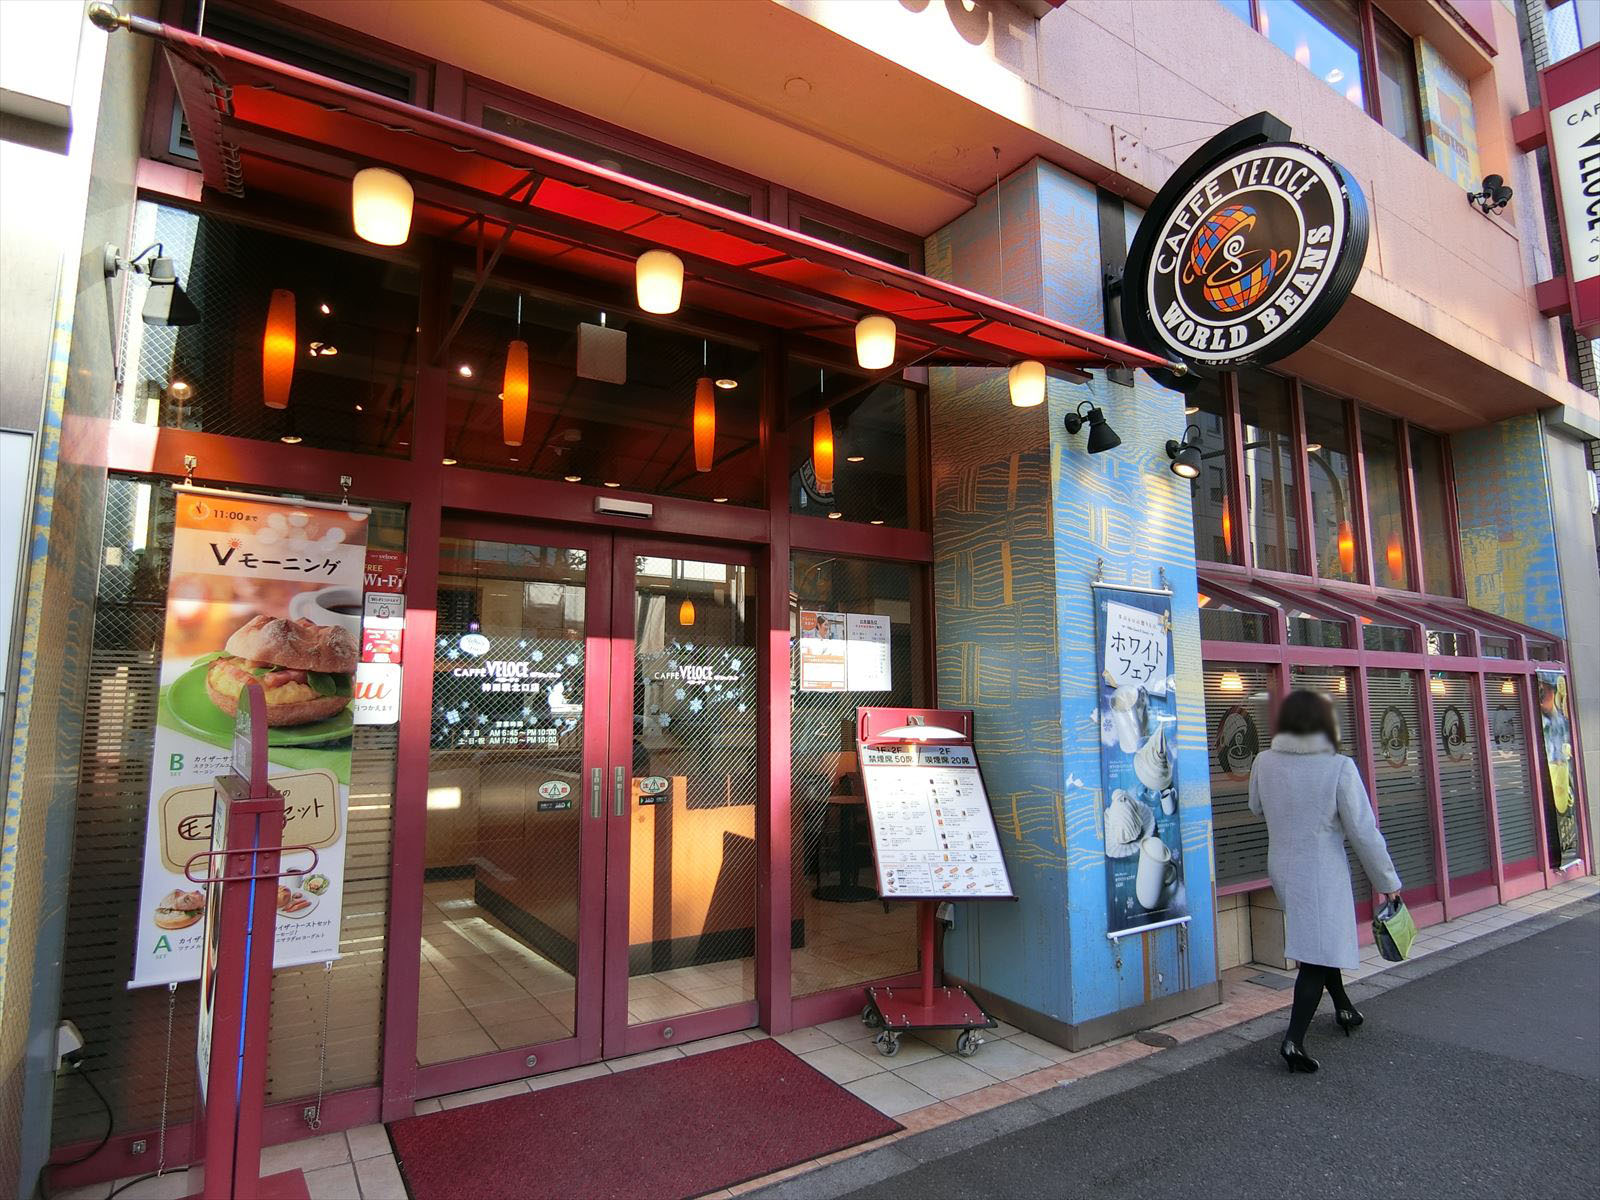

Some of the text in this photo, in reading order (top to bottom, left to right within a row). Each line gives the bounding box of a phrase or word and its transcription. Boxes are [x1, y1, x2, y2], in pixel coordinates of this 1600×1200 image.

[1232, 158, 1319, 201] VELOCE
[1162, 225, 1332, 351] WORLD BEANS
[1110, 631, 1164, 665] ホワイト
[486, 660, 529, 678] VELOCE
[679, 665, 714, 680] VELOCE
[1119, 657, 1157, 684] フェア
[489, 729, 501, 737] AM
[938, 747, 952, 755] 2F
[169, 753, 185, 771] B
[276, 919, 332, 931] イザートーストセット
[152, 934, 172, 954] A
